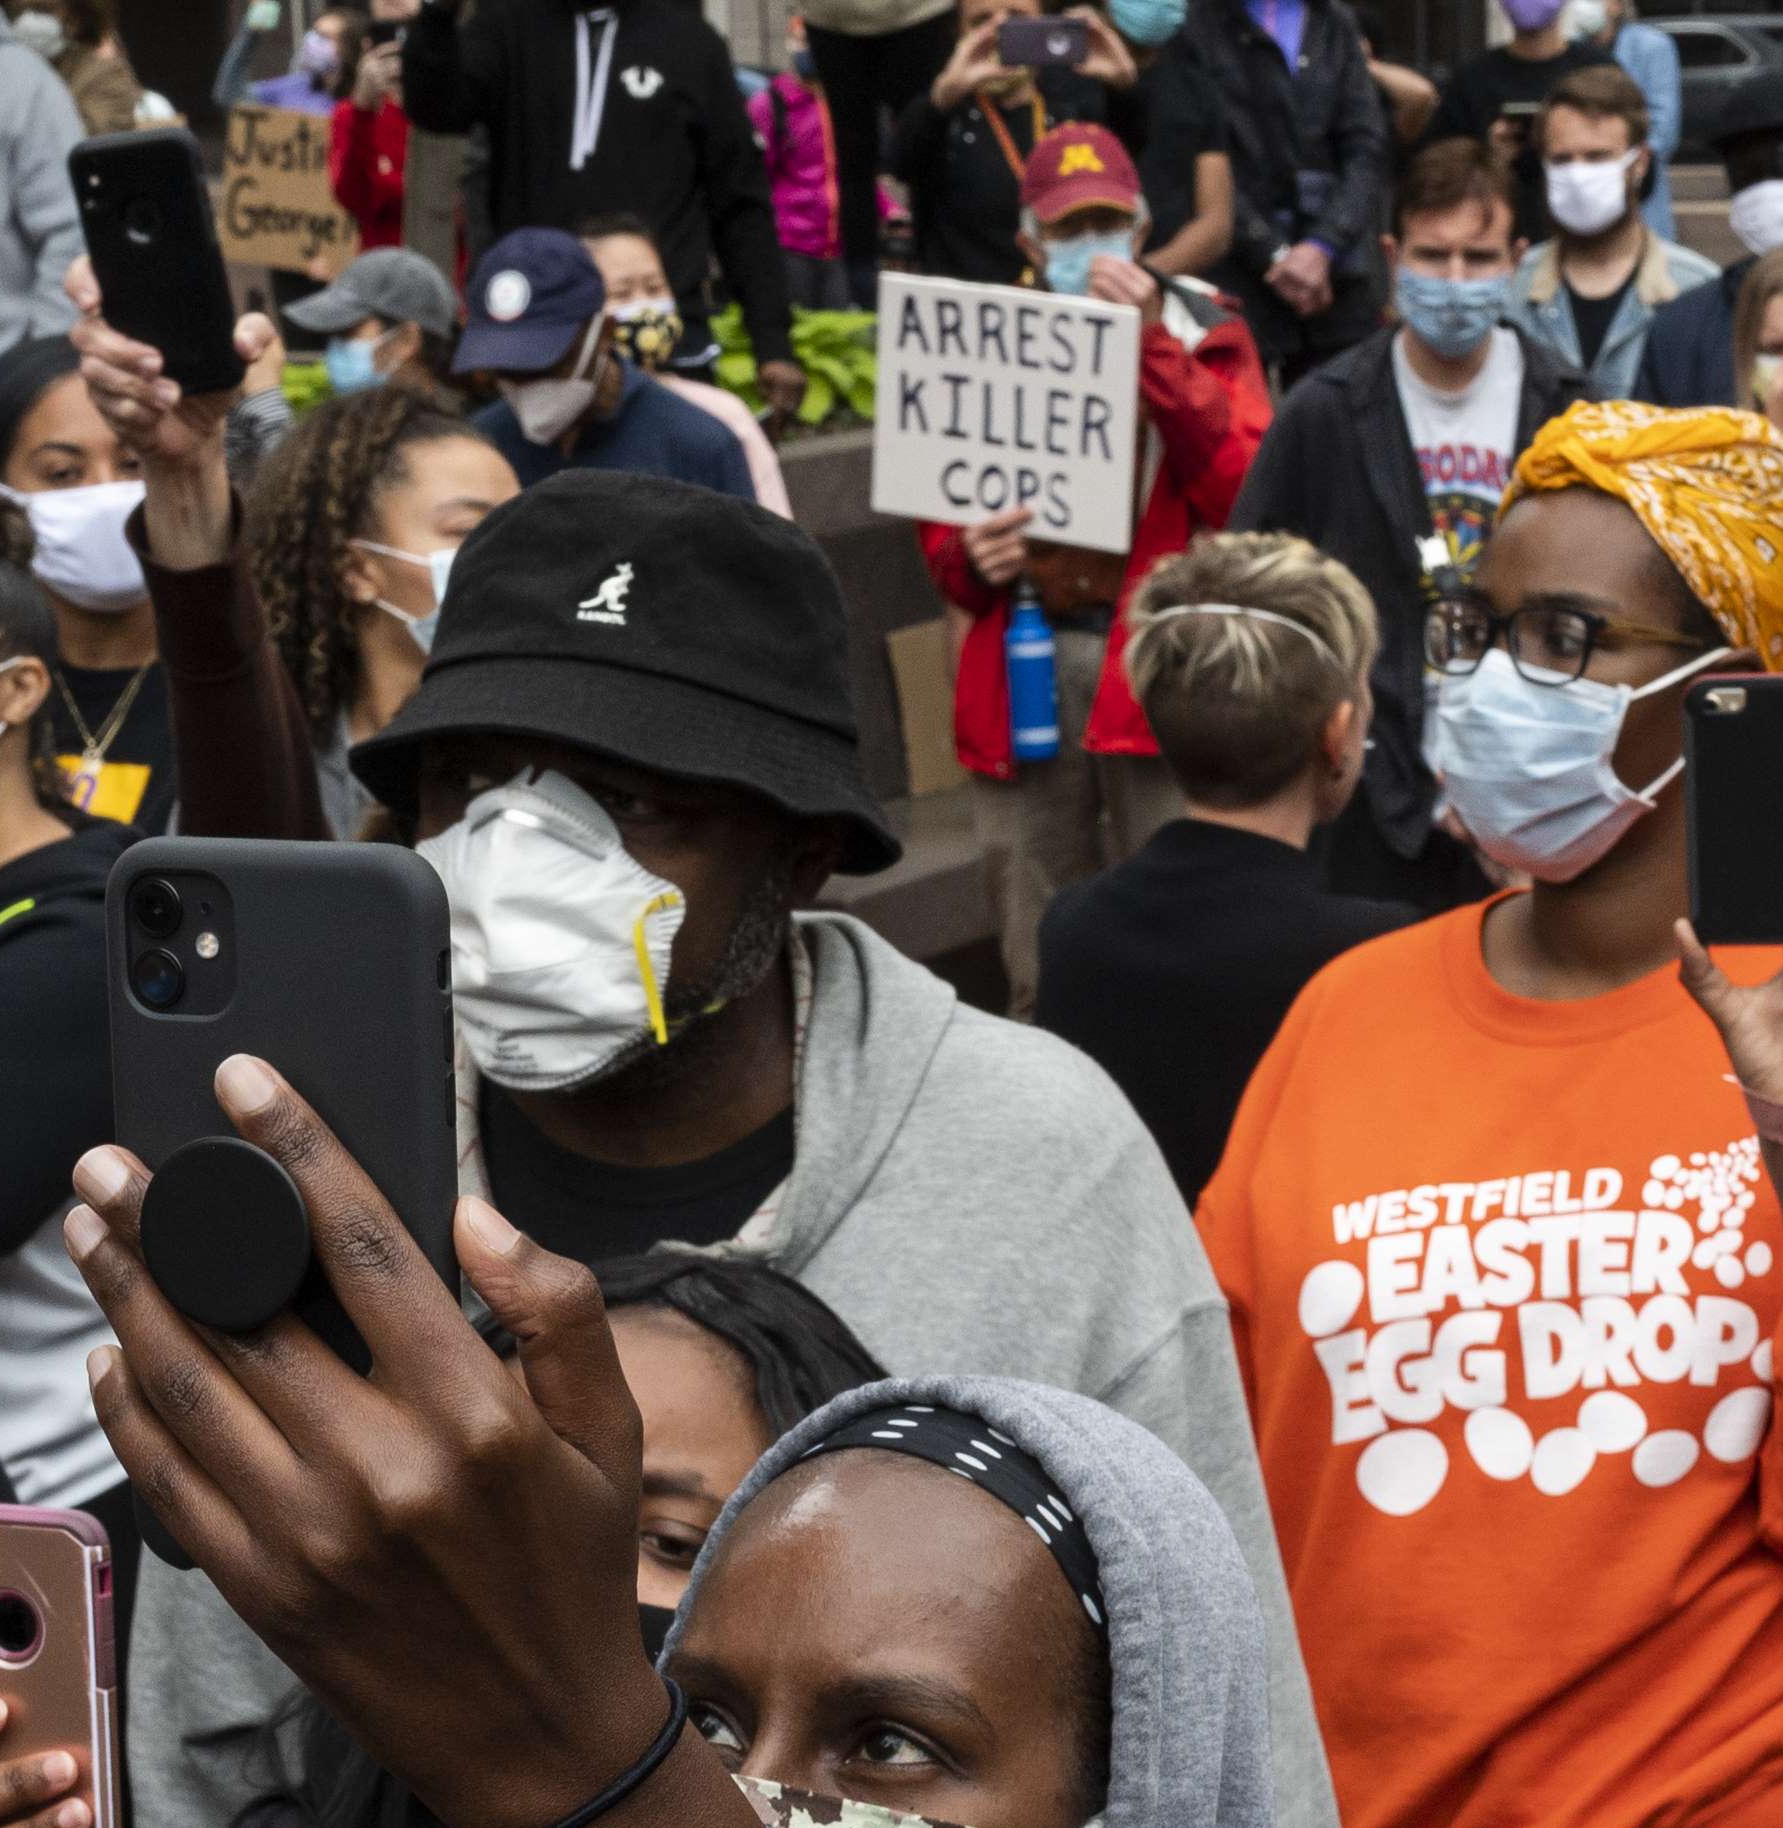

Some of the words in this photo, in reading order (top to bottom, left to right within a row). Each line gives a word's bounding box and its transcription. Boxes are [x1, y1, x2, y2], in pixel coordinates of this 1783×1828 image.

[898, 294, 1114, 377] ARREST
[898, 371, 1113, 460] KILLER
[940, 457, 1072, 529] COPS
[1332, 1167, 1623, 1244] WESTFIELD
[1367, 1210, 1694, 1324] EASTER
[1313, 1311, 1508, 1446] EGG
[1517, 1293, 1740, 1400] DROP
